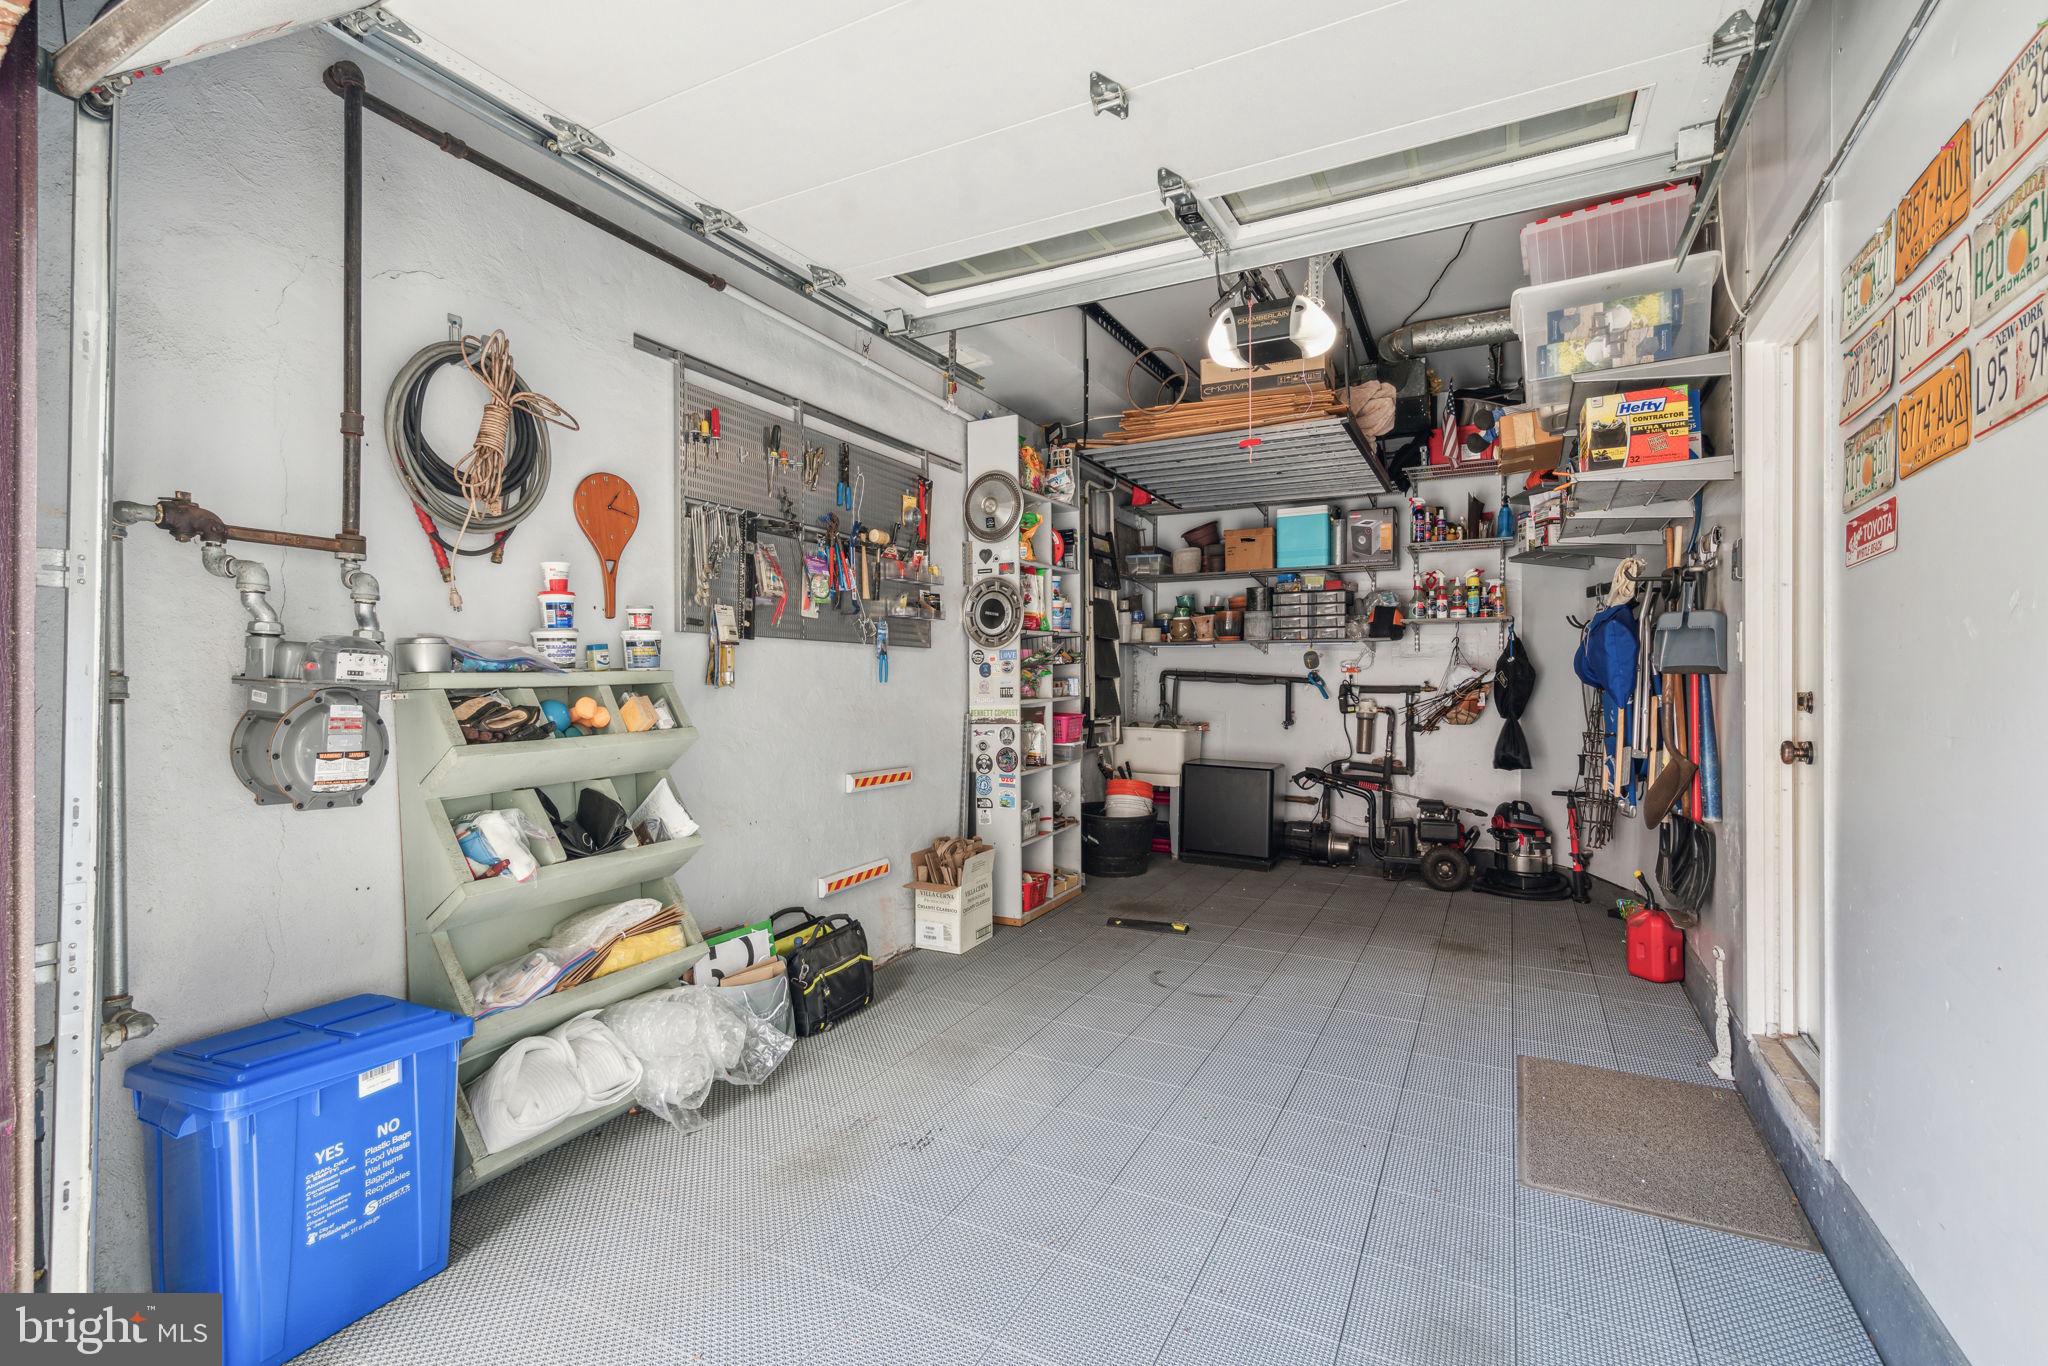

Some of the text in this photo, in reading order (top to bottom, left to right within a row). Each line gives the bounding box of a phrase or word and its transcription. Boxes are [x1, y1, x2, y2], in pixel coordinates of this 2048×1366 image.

[1995, 37, 2042, 100] NEW YORK
[1974, 96, 2005, 179] HGK
[1910, 218, 1944, 261] NEW YORK
[1912, 267, 1947, 304] NEW YORK
[1995, 257, 2040, 302] BROWARD
[1937, 266, 1963, 329] 756
[1237, 309, 1289, 325] CHAMBERLAIN
[1995, 301, 2044, 346] NEW YORK
[1976, 346, 2008, 416] L95
[1619, 401, 1663, 414] Hefty
[1632, 411, 1685, 423] CONTRACTOR
[1901, 372, 1963, 452] 8774-ACR
[1662, 421, 1686, 429] THICK
[1914, 435, 1947, 464] NEW YORK
[1863, 512, 1892, 541] TOYOTA
[1001, 651, 1017, 660] LOVE
[377, 1117, 400, 1139] NO
[314, 1142, 344, 1165] YES
[365, 1130, 412, 1157] Plastic Bags
[365, 1141, 411, 1167] Food Waste
[365, 1153, 403, 1177] Wet Items
[365, 1167, 395, 1187] Bagged
[365, 1170, 411, 1198] Recyclables
[319, 1218, 356, 1240] Philadelphia
